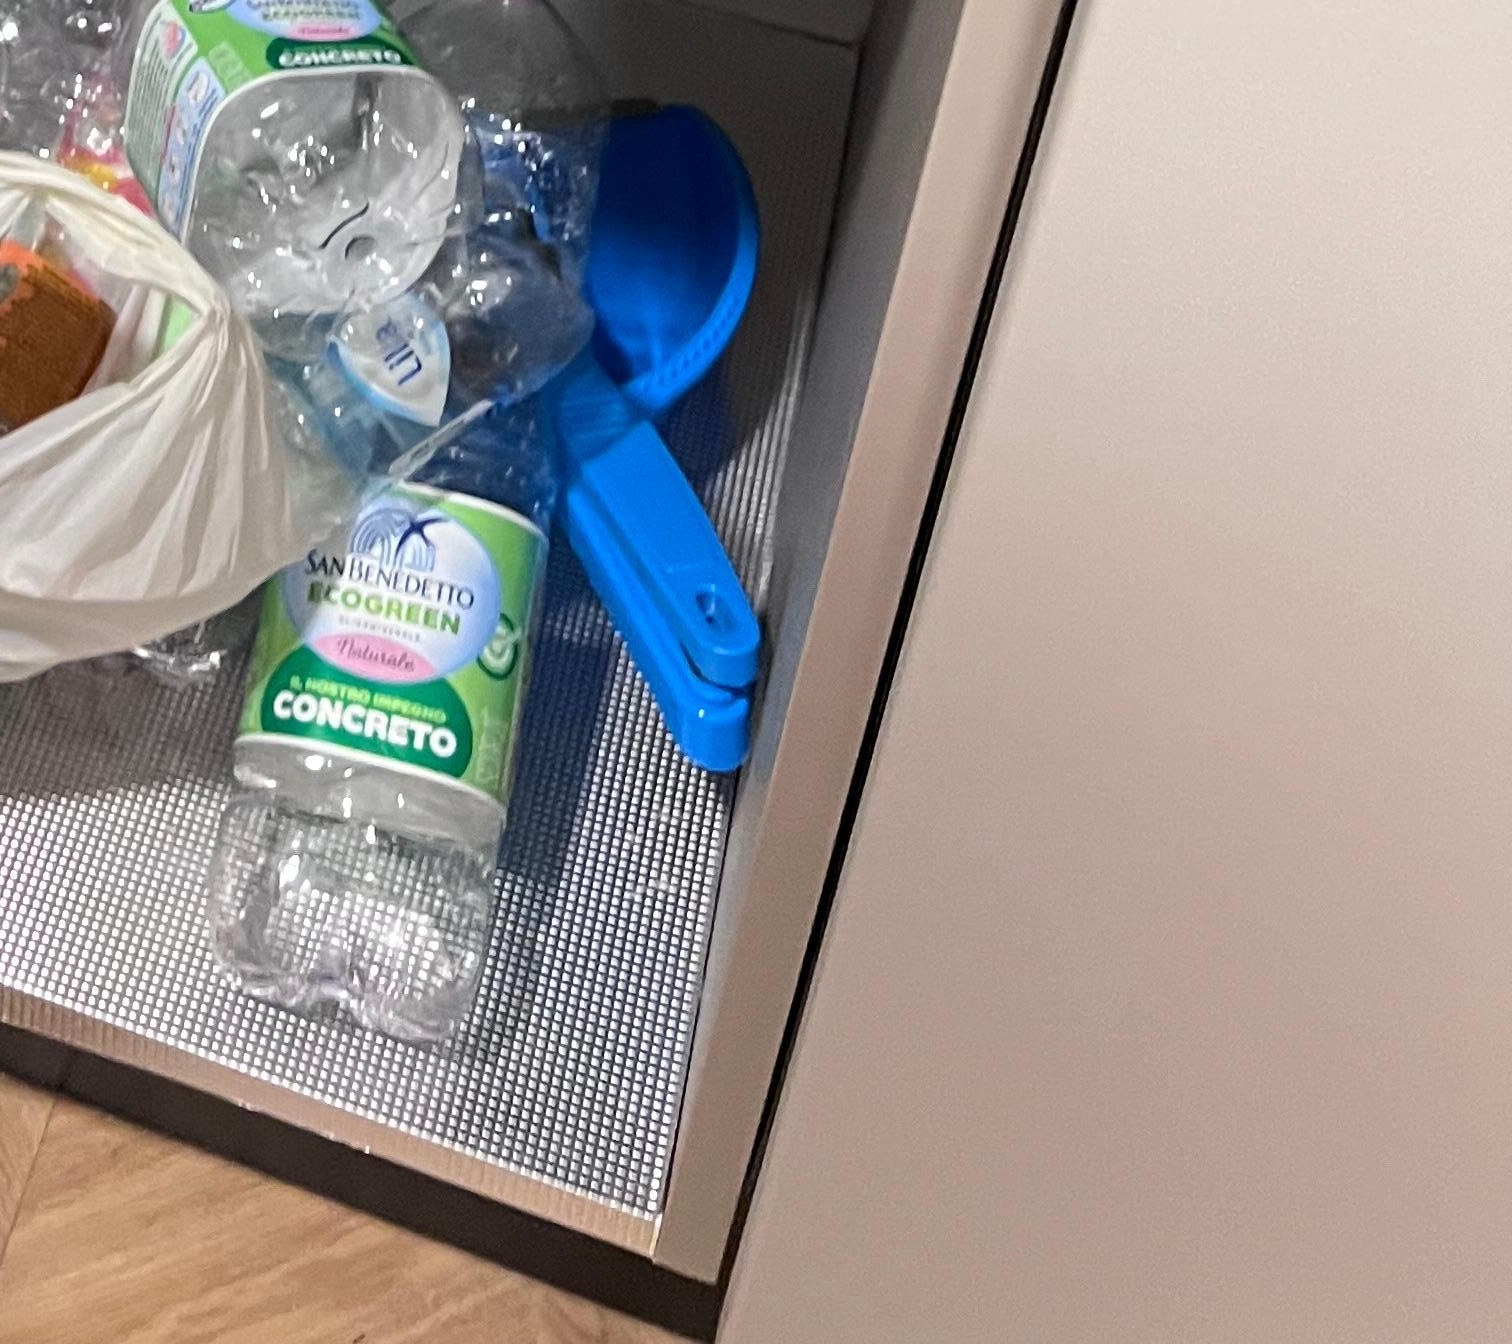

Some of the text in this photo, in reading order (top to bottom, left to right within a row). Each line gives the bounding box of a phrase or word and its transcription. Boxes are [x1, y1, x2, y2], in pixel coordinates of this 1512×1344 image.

[307, 582, 460, 635] ECOGREEN
[336, 638, 416, 674] Naturale
[272, 690, 458, 758] CONCRETO
